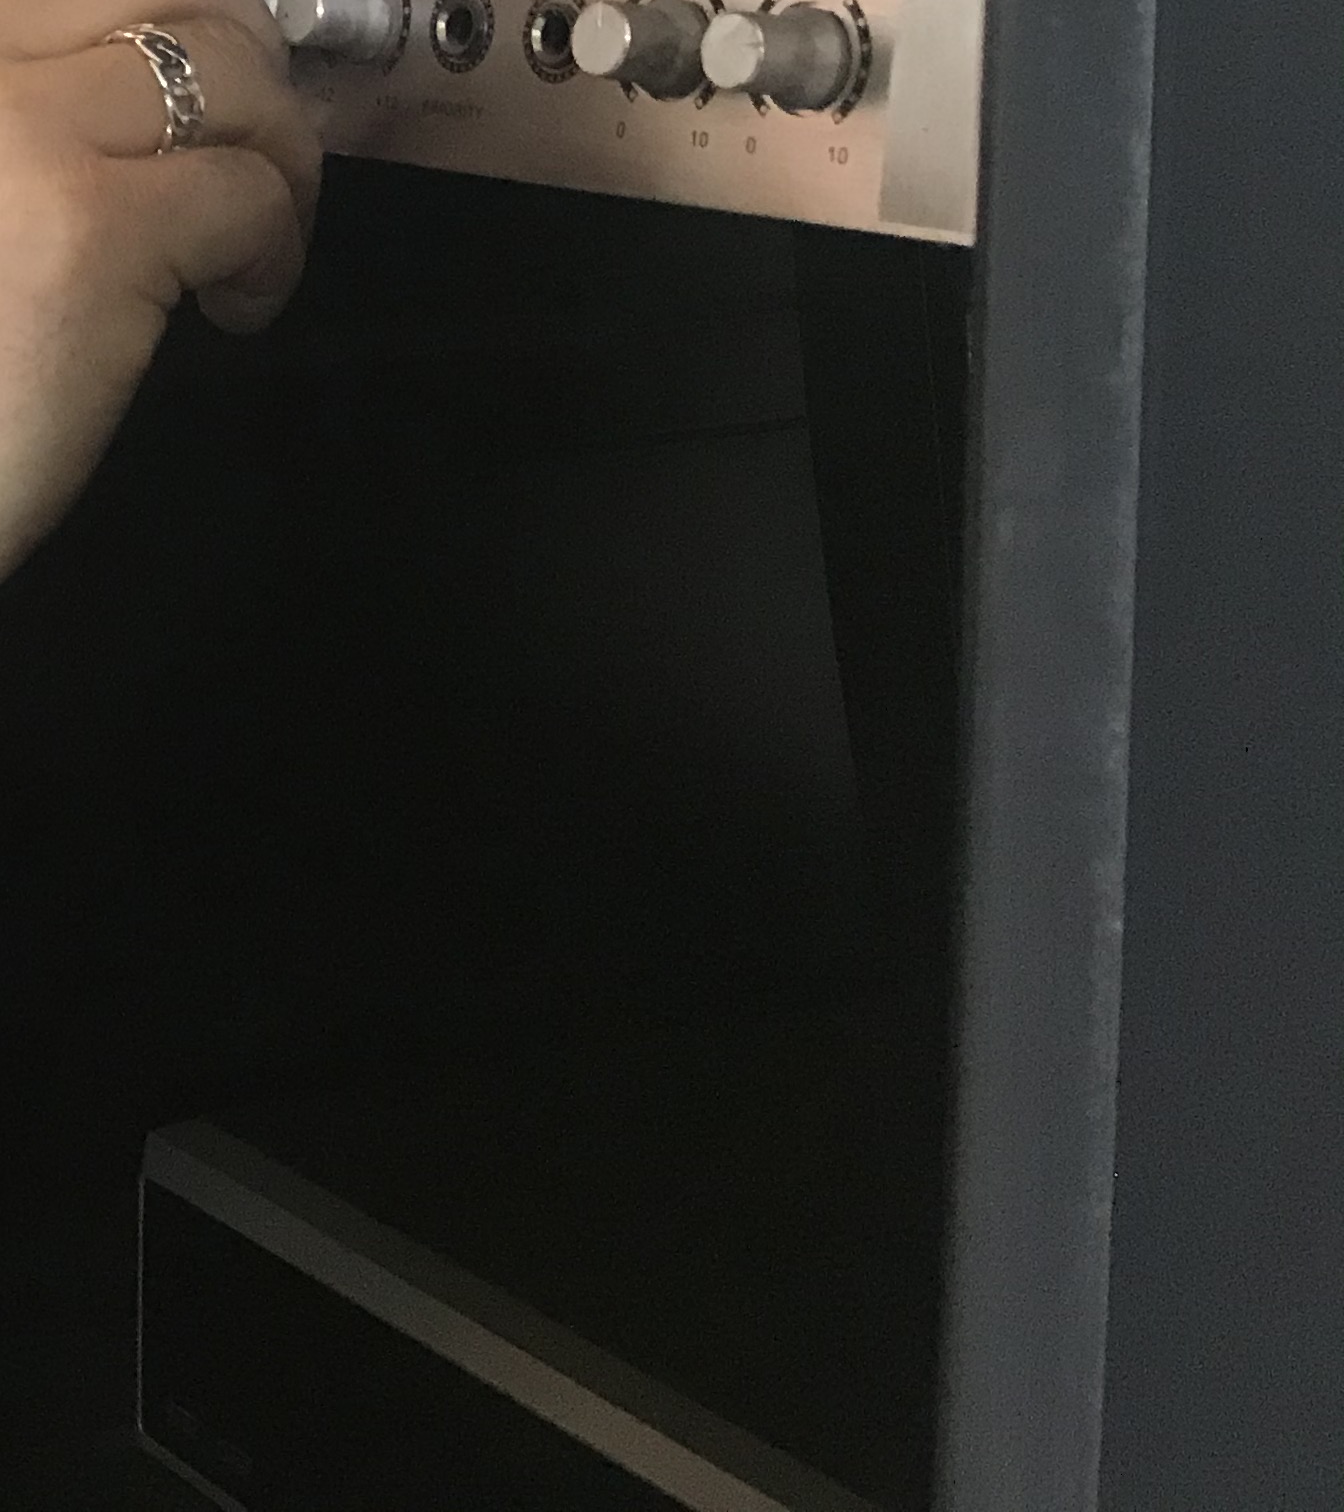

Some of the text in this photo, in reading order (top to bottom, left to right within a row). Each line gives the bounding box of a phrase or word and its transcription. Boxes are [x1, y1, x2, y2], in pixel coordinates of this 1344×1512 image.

[616, 121, 626, 138] 0
[692, 130, 709, 148] 10
[745, 136, 756, 154] 0
[828, 146, 849, 164] 10
